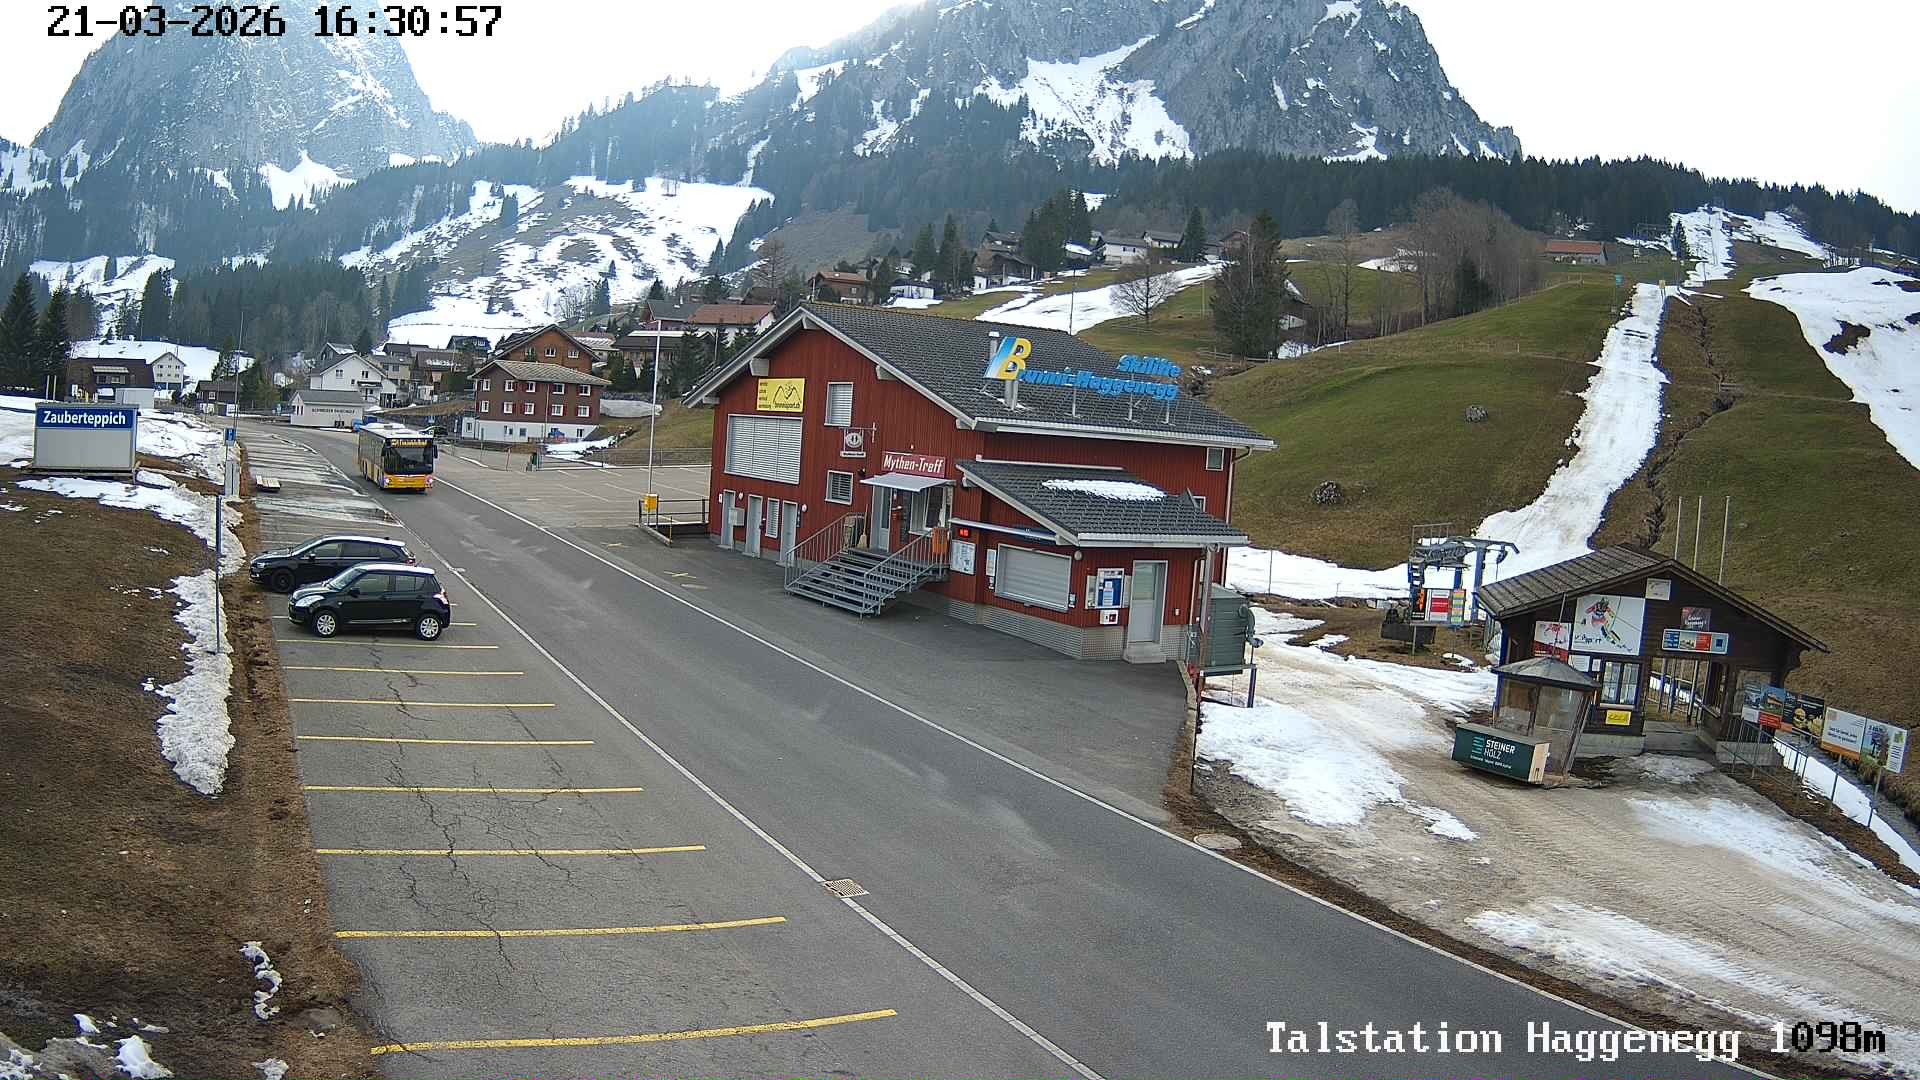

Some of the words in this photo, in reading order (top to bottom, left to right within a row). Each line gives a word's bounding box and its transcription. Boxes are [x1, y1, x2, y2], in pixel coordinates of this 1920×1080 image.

[1118, 354, 1182, 379] Skilifte
[42, 410, 126, 428] Zauberteppich
[883, 455, 943, 473] Mythen-Treff
[1484, 748, 1502, 760] HOLZ
[1486, 739, 1516, 755] STEINER
